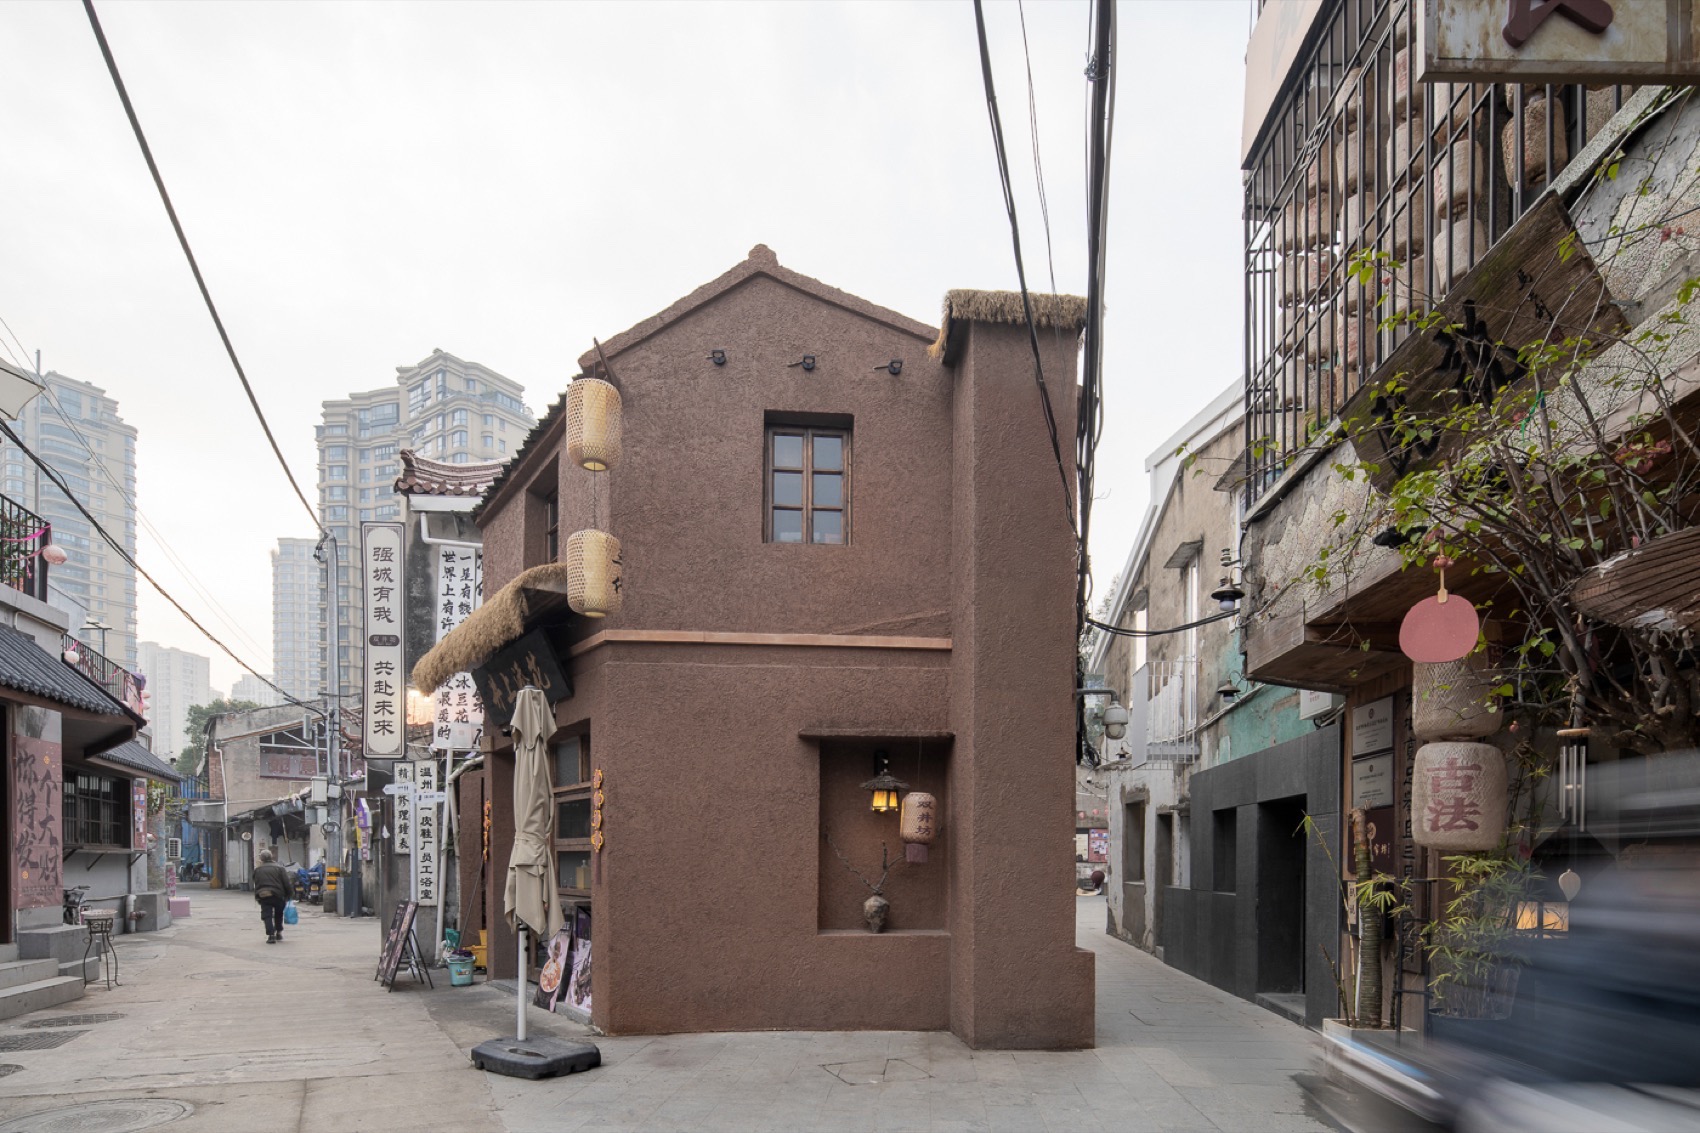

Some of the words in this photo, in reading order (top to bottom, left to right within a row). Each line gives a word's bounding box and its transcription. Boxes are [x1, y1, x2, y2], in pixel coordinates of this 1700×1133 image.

[373, 547, 395, 624] 强城有我
[373, 660, 395, 736] 共赴未来
[419, 766, 433, 900] 温州一皮鞋厂员工浴室
[915, 800, 934, 836] 双井坊
[1426, 757, 1483, 833] 古法
